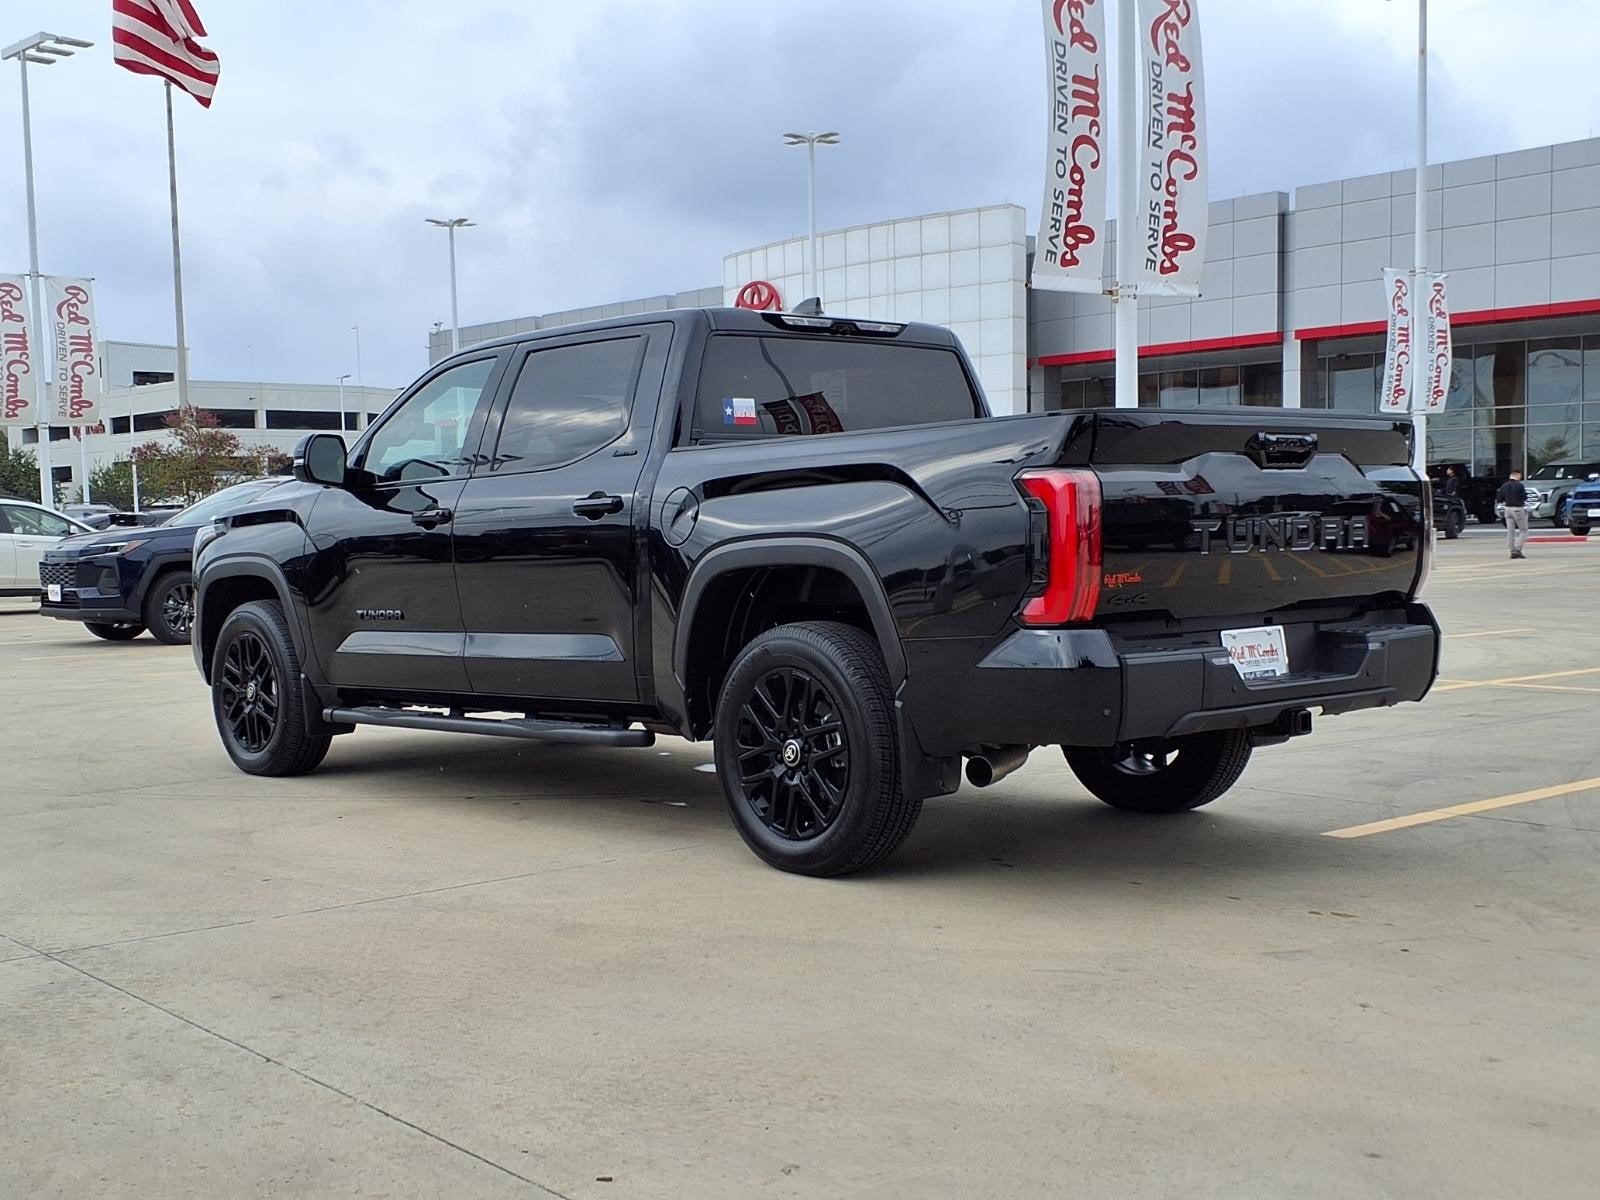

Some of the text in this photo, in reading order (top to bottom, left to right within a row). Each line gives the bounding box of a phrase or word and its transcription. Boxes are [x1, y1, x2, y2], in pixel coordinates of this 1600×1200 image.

[1045, 41, 1068, 264] DRIVEN TO SERVE
[1060, 63, 1101, 268] McCombs
[1145, 60, 1163, 272] DRIVEN TO SERVE
[1159, 80, 1198, 275] McCombs
[56, 285, 90, 326] Red
[1392, 278, 1408, 316] Red
[4, 326, 30, 419] McCombs
[56, 321, 68, 418] DRIVEN TO SERVE
[69, 328, 95, 419] McCombs
[1385, 374, 1393, 405] SERVE
[1388, 358, 1395, 371] TO
[1427, 359, 1434, 372] TO
[1189, 515, 1370, 556] TUNDRA
[356, 609, 405, 620] TUNDRA
